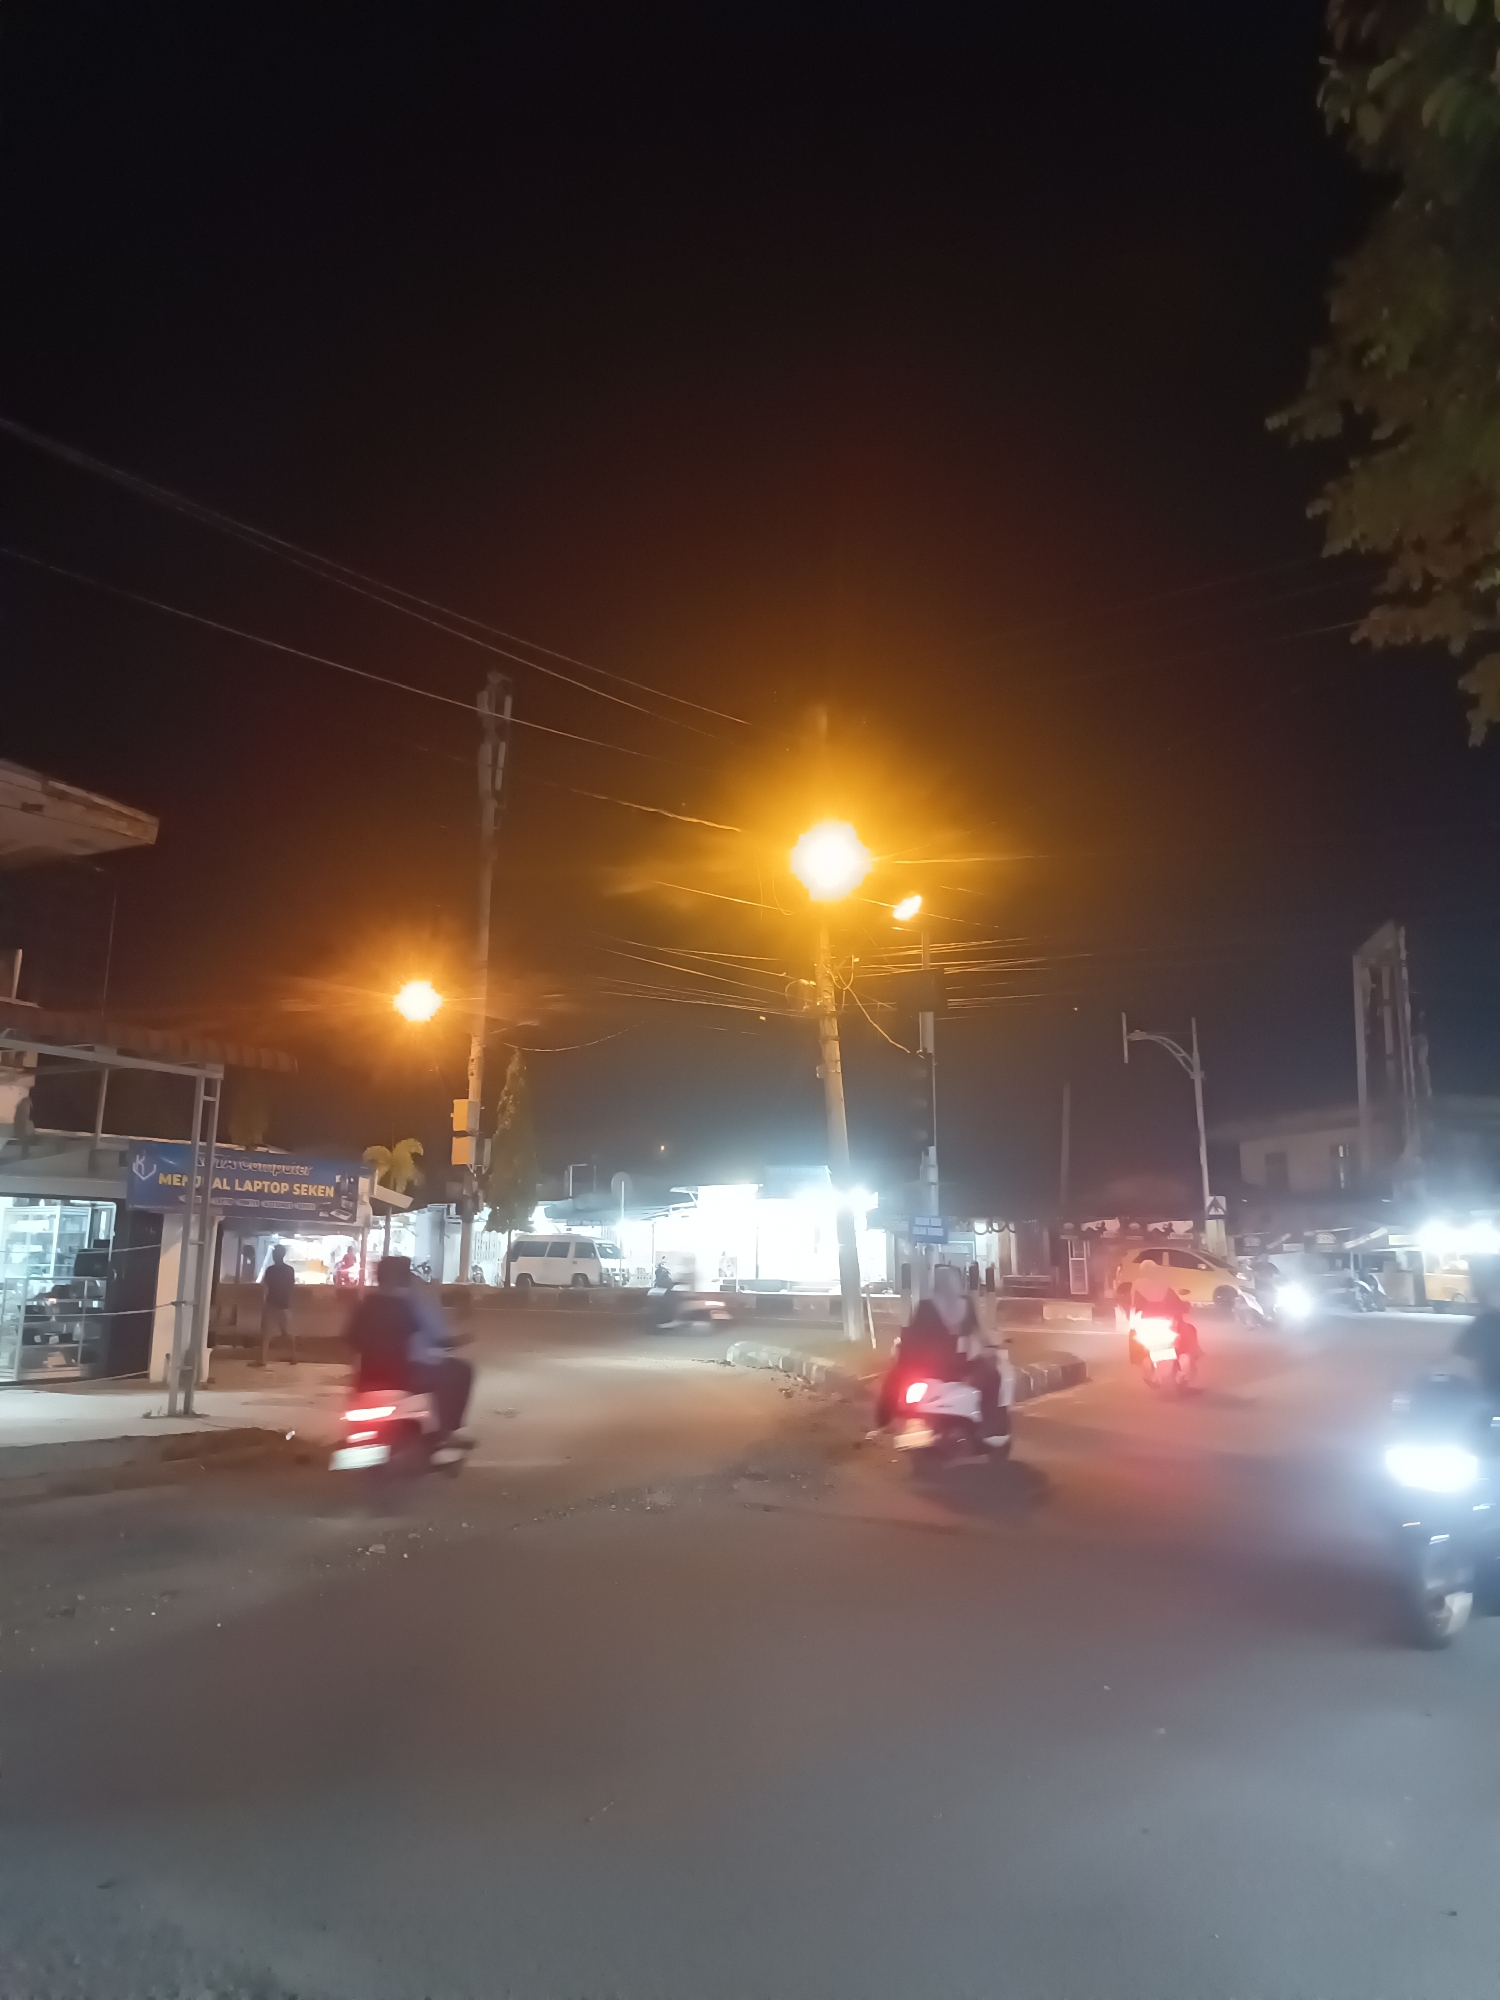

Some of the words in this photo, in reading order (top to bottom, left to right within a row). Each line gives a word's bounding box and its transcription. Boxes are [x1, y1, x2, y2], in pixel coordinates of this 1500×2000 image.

[240, 1157, 313, 1177] Computer
[158, 1173, 231, 1191] MENJAL
[235, 1178, 290, 1195] LAPTOP
[292, 1183, 335, 1198] SEKEN
